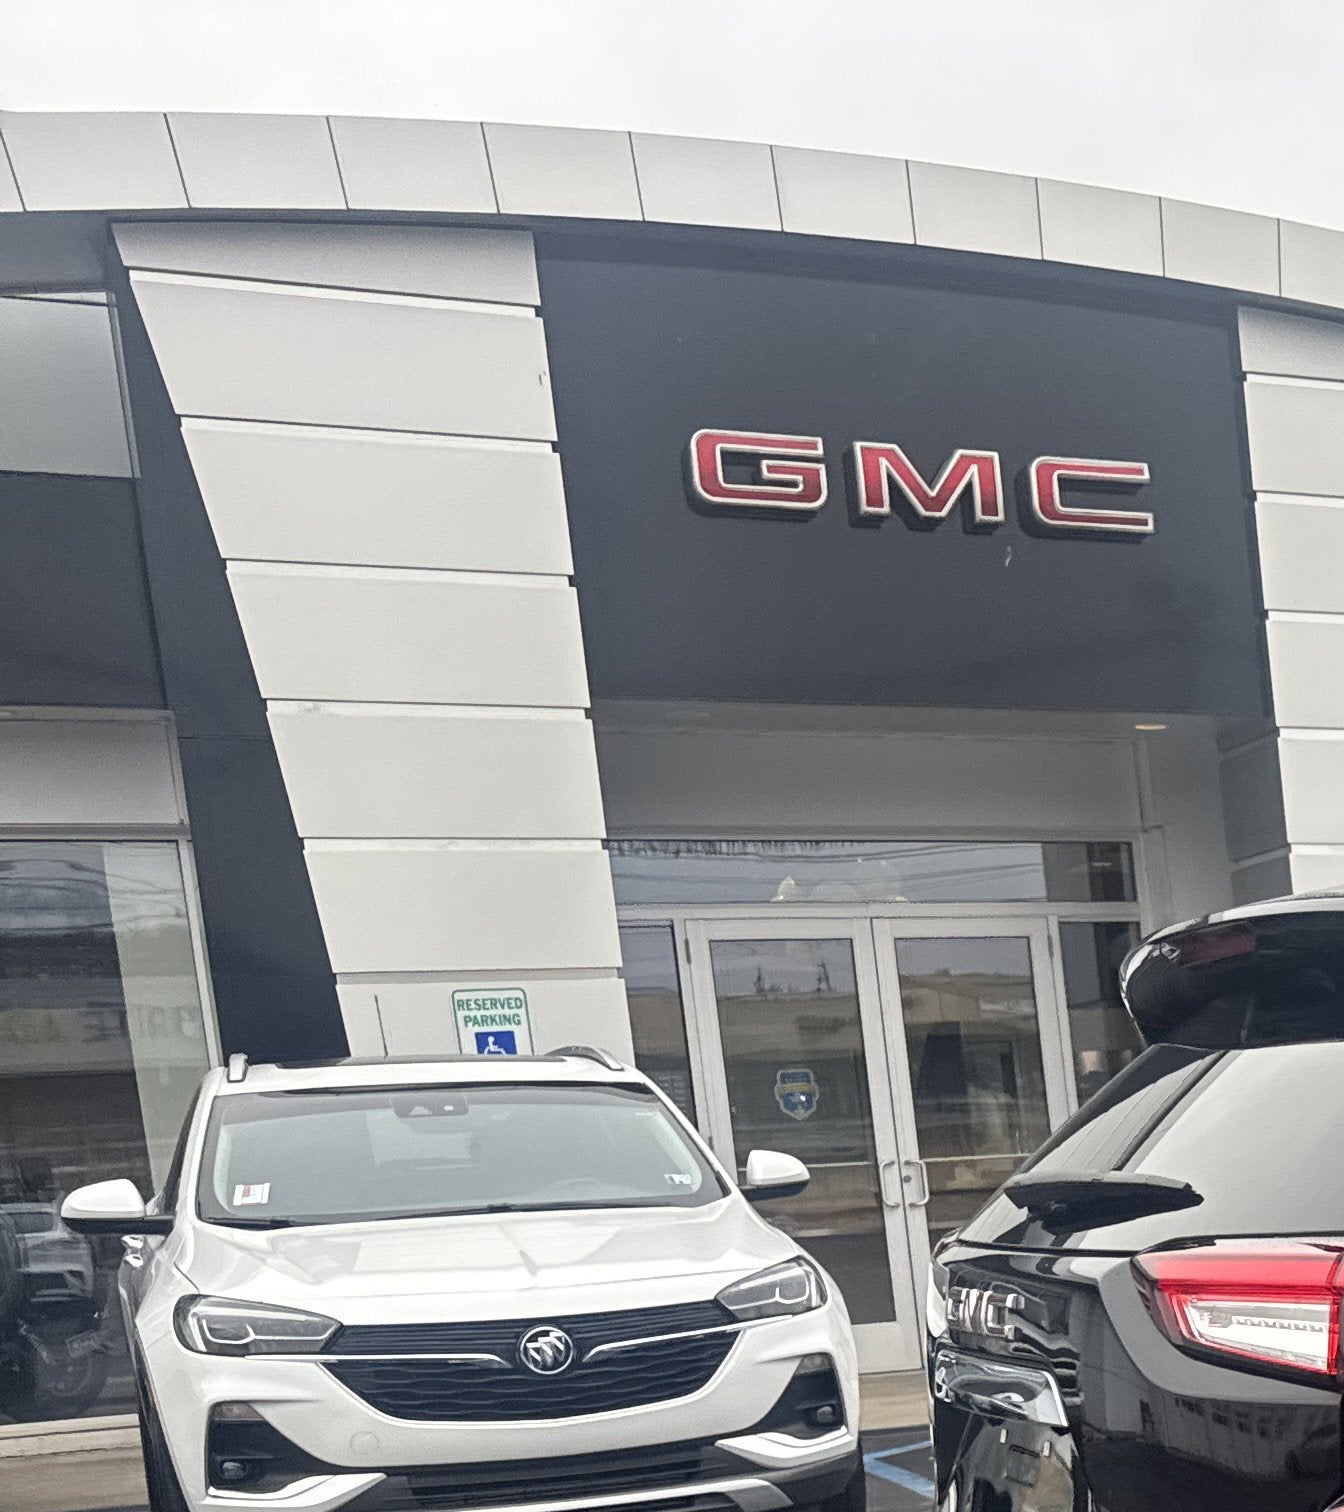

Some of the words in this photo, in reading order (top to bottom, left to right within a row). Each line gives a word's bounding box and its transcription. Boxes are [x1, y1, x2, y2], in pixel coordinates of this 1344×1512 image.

[692, 429, 1154, 533] GMC
[456, 997, 523, 1012] RESERVED
[463, 1014, 522, 1028] PARKING
